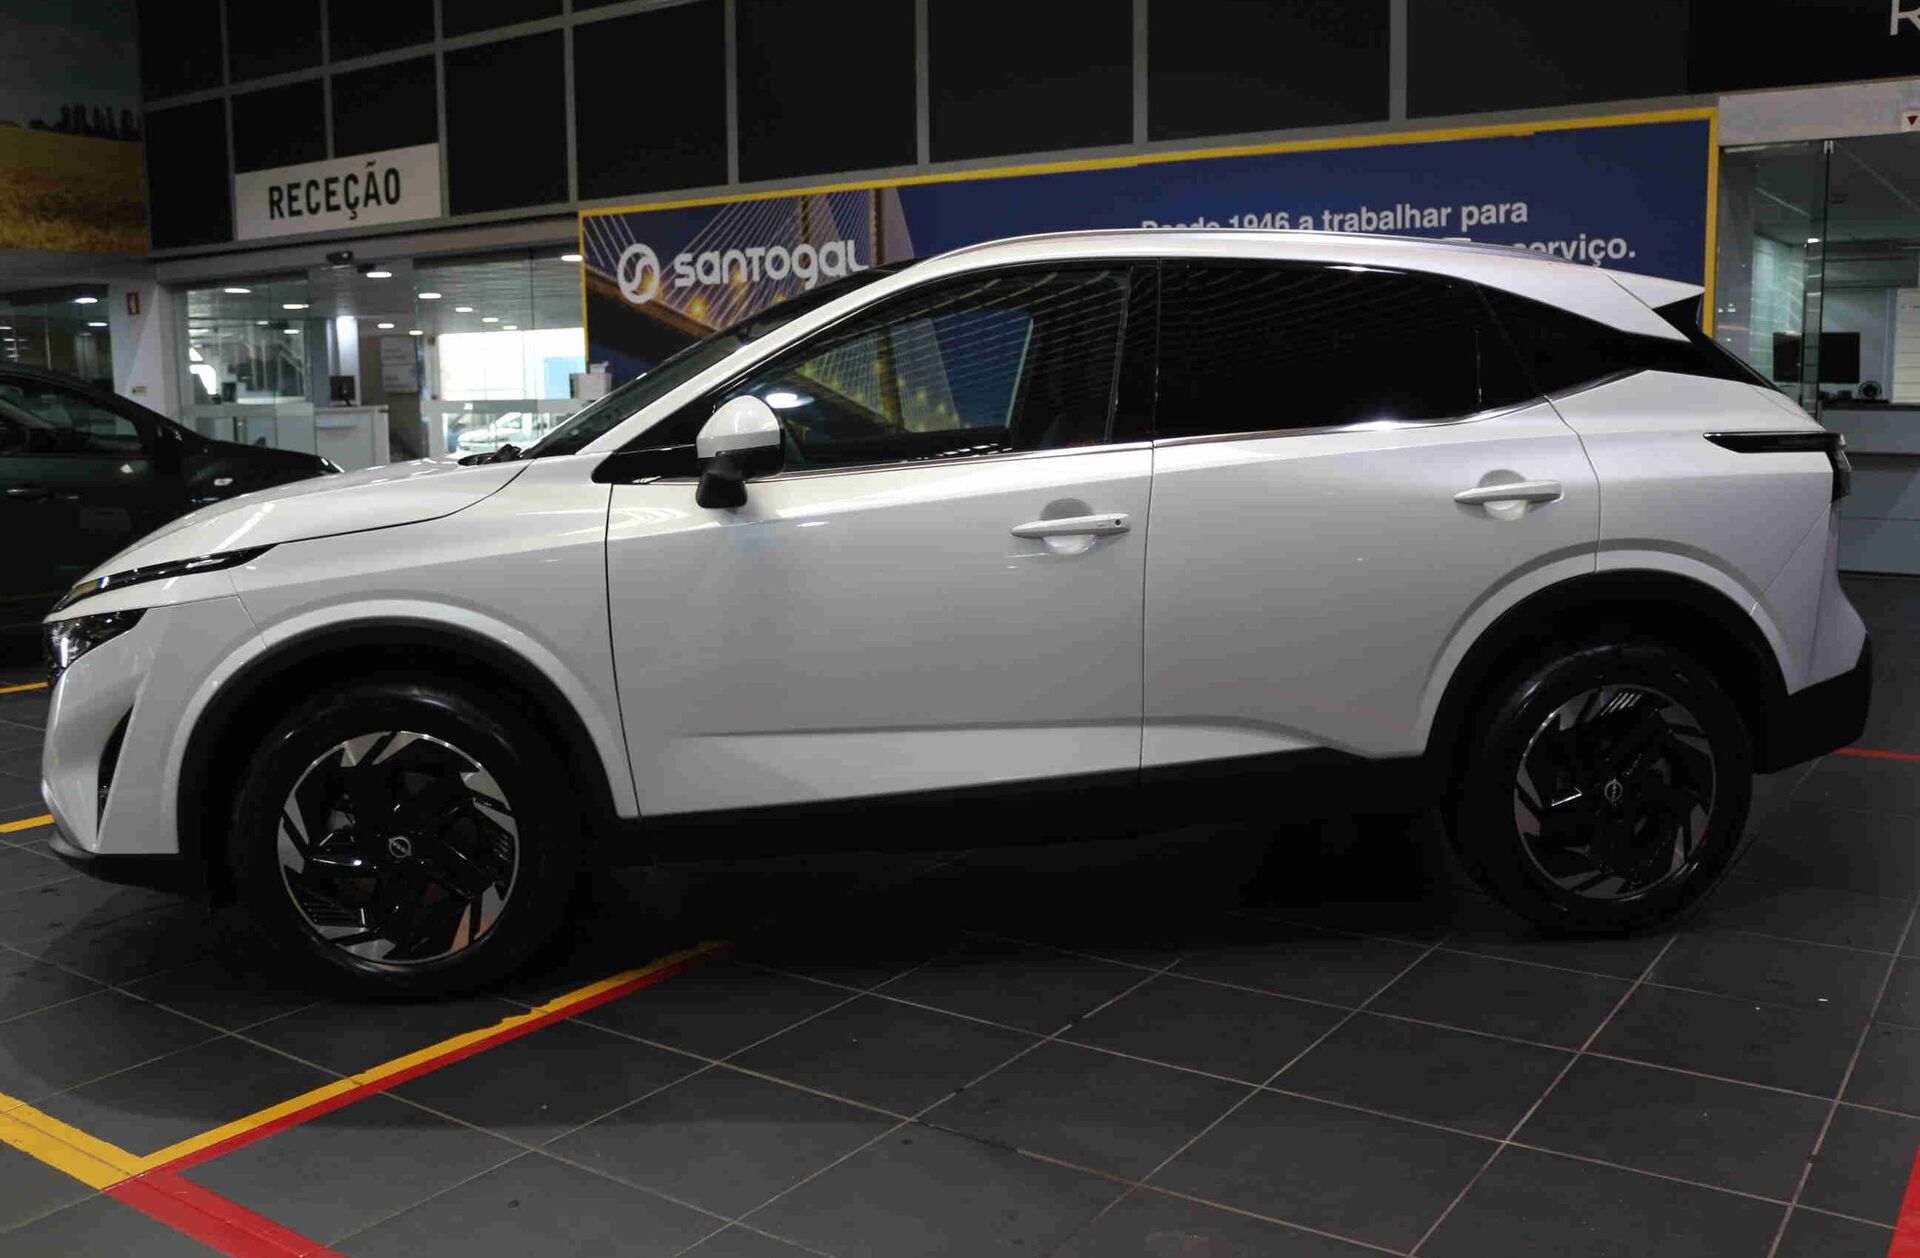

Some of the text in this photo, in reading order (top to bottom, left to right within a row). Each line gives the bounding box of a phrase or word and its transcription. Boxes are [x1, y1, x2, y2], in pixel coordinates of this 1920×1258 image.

[268, 159, 401, 221] RECEÇÃO
[1299, 215, 1314, 230] a
[1322, 203, 1452, 232] trabalhar
[1461, 201, 1528, 232] para
[1512, 232, 1637, 267] rviço.
